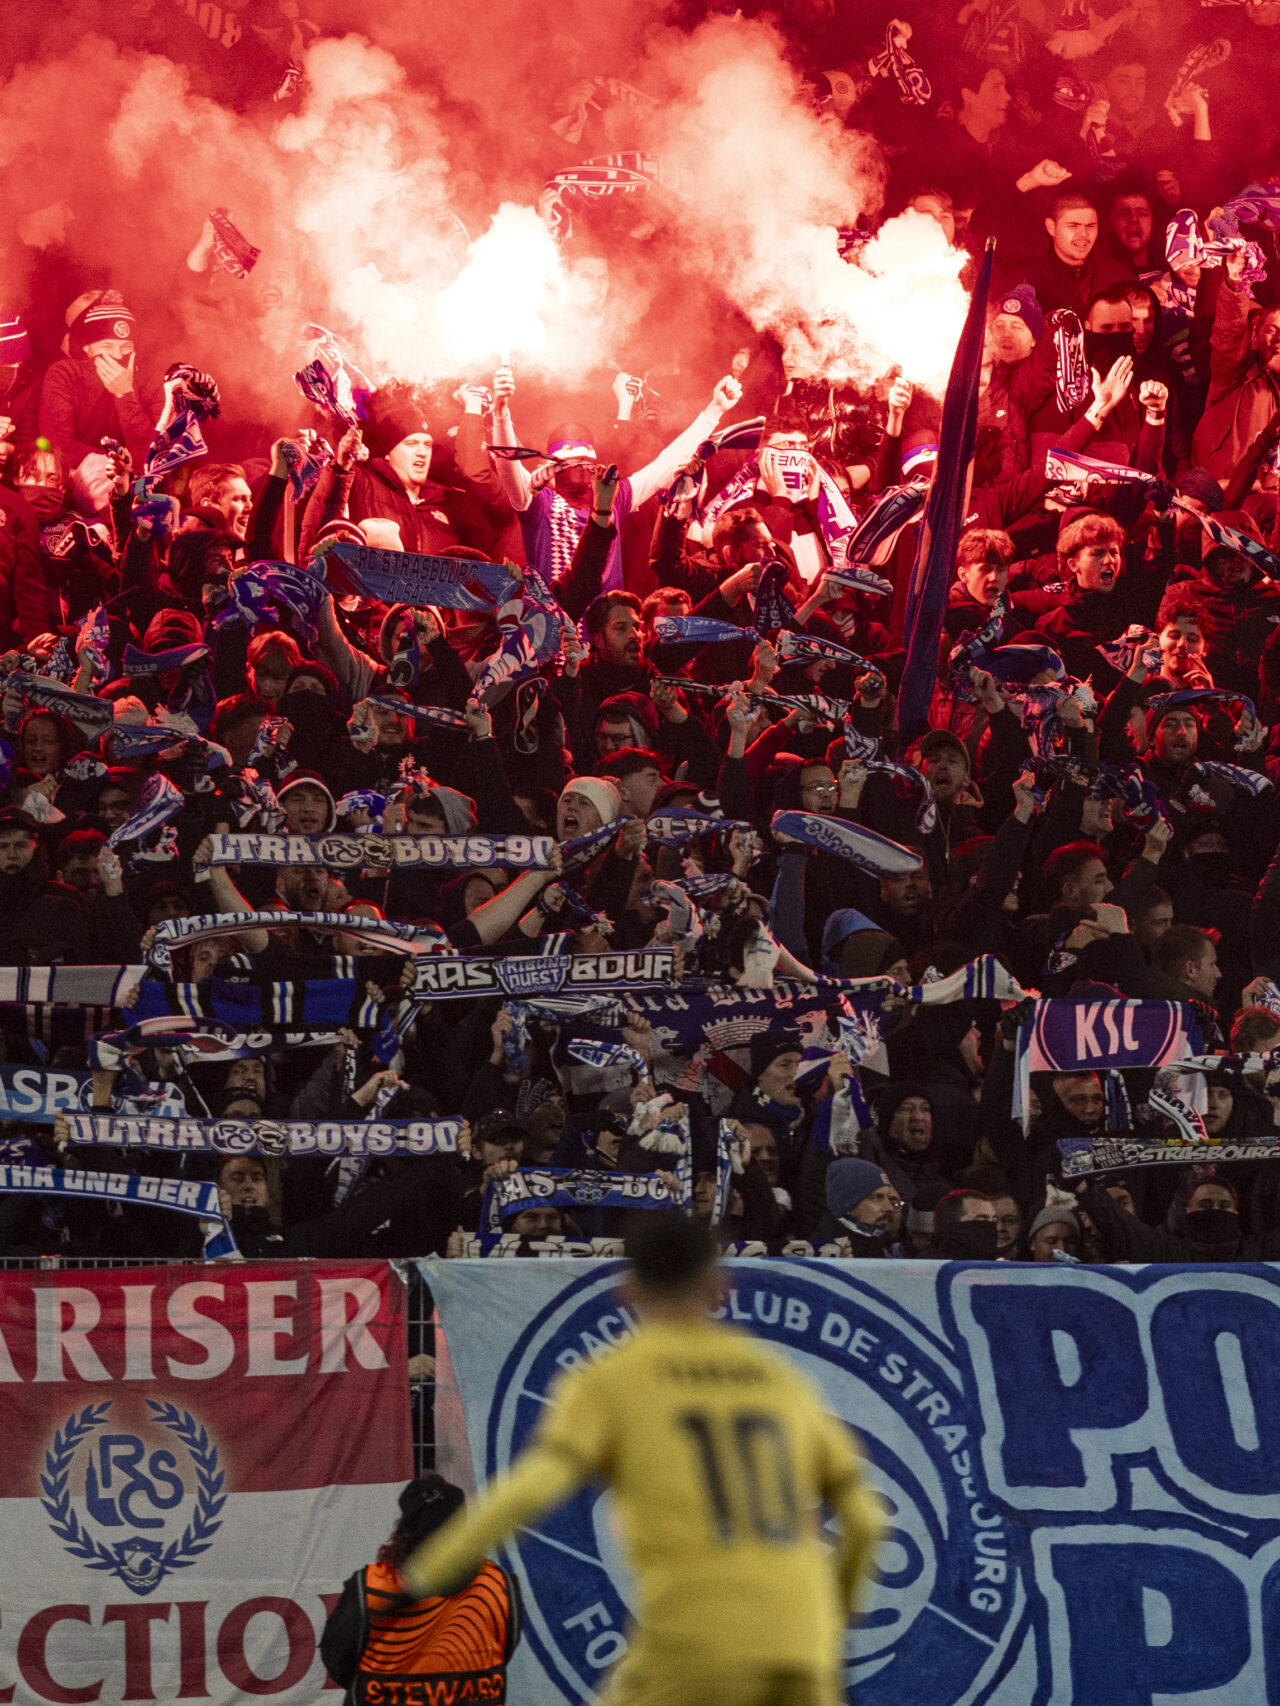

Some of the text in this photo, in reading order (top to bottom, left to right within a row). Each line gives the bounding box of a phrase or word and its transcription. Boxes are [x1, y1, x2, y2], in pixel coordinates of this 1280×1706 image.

[381, 553, 478, 585] STRASBOURG
[385, 579, 437, 602] ALSACE
[508, 968, 560, 988] OUEST
[1075, 998, 1143, 1061] KSC
[64, 1113, 204, 1150] ULTRA
[63, 1169, 130, 1196] UND
[137, 1175, 203, 1208] DER
[676, 1408, 802, 1547] 10
[819, 1312, 880, 1364] DE
[878, 1352, 1008, 1614] STRASBOURG
[0, 1595, 348, 1703] CTIO
[365, 1673, 506, 1706] STEWARD
